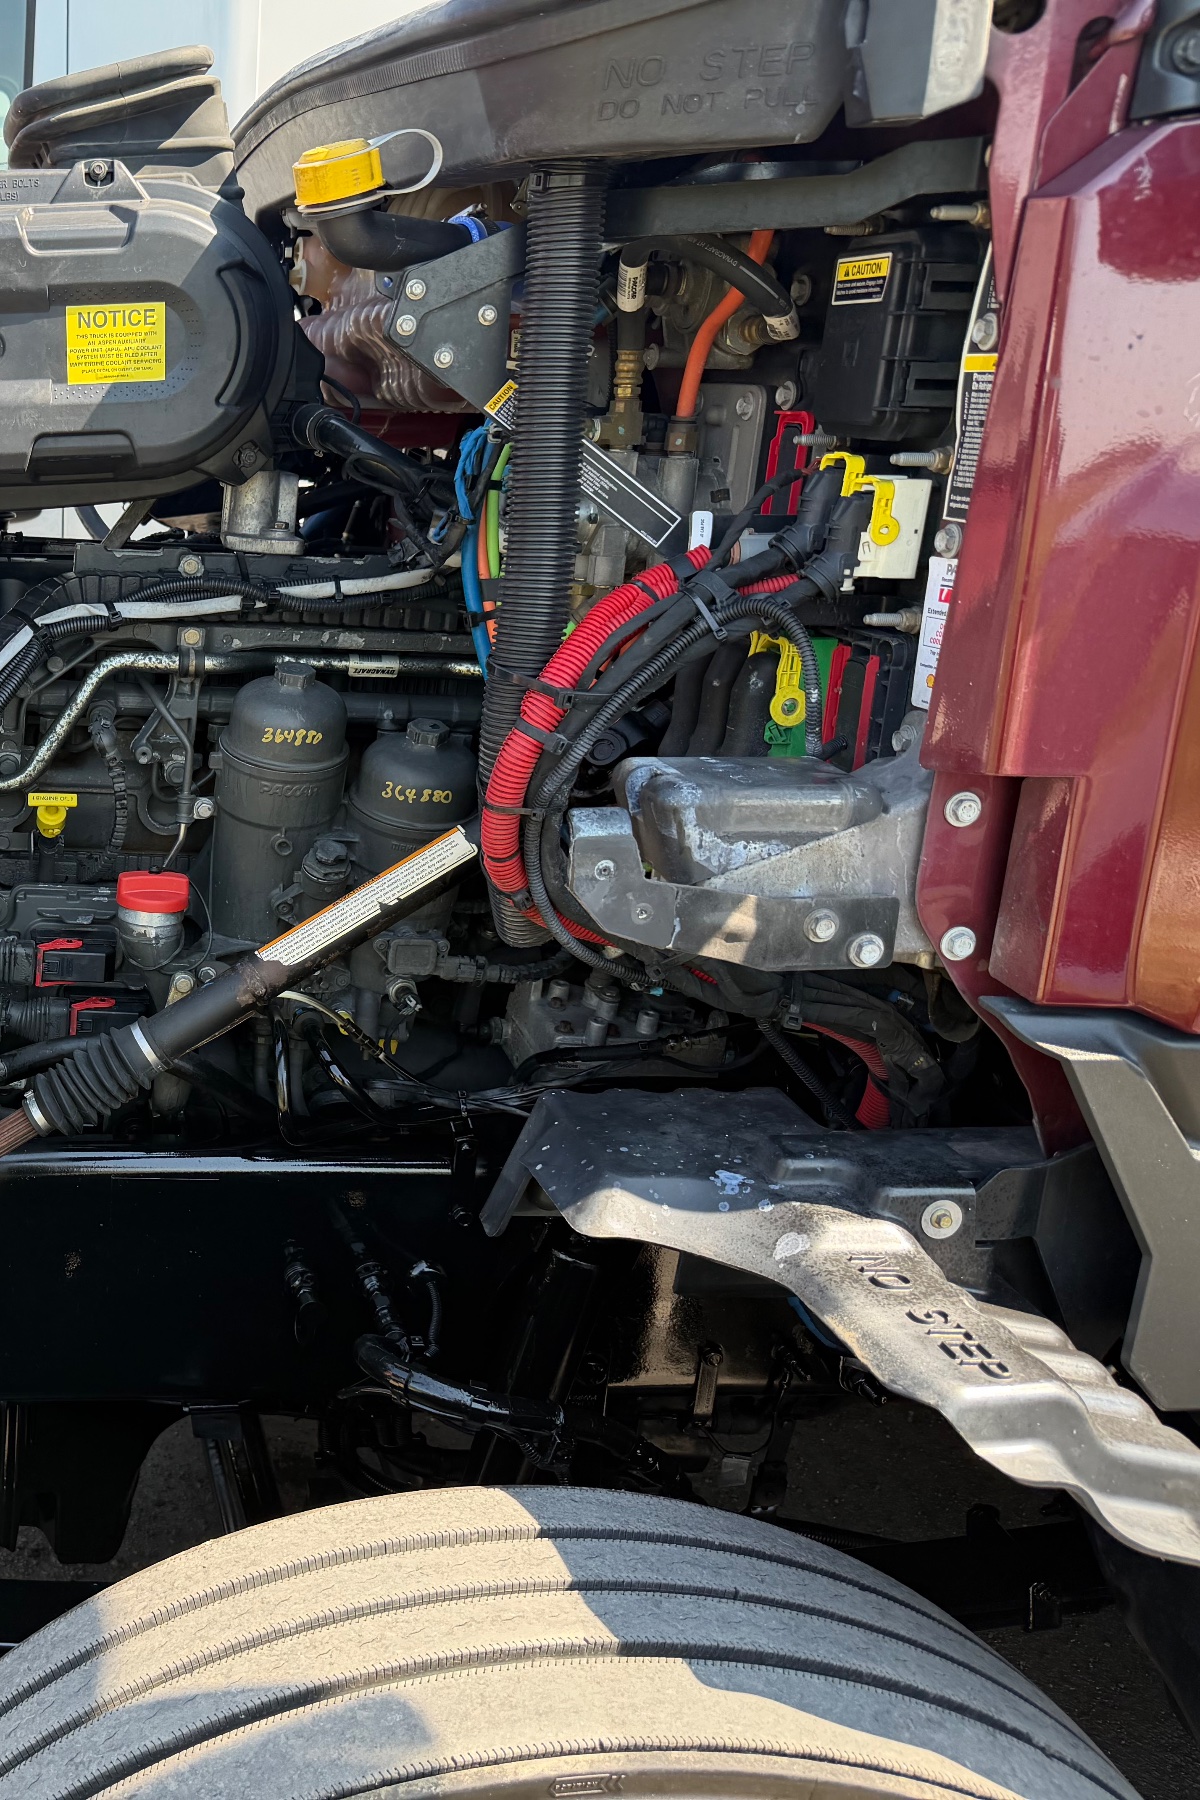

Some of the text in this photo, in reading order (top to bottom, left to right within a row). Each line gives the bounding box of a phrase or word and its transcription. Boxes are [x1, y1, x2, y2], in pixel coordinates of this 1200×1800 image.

[604, 41, 815, 91] NO STEP
[597, 86, 819, 122] DO NOT PULL
[13, 179, 40, 188] BOLTS
[851, 261, 883, 276] CAUTION
[77, 309, 156, 329] NOTICE
[489, 384, 513, 411] CAUTION
[927, 607, 947, 617] Extended
[262, 728, 322, 746] 364880
[259, 780, 320, 798] PACCAR
[847, 1255, 1014, 1381] NO STEP
